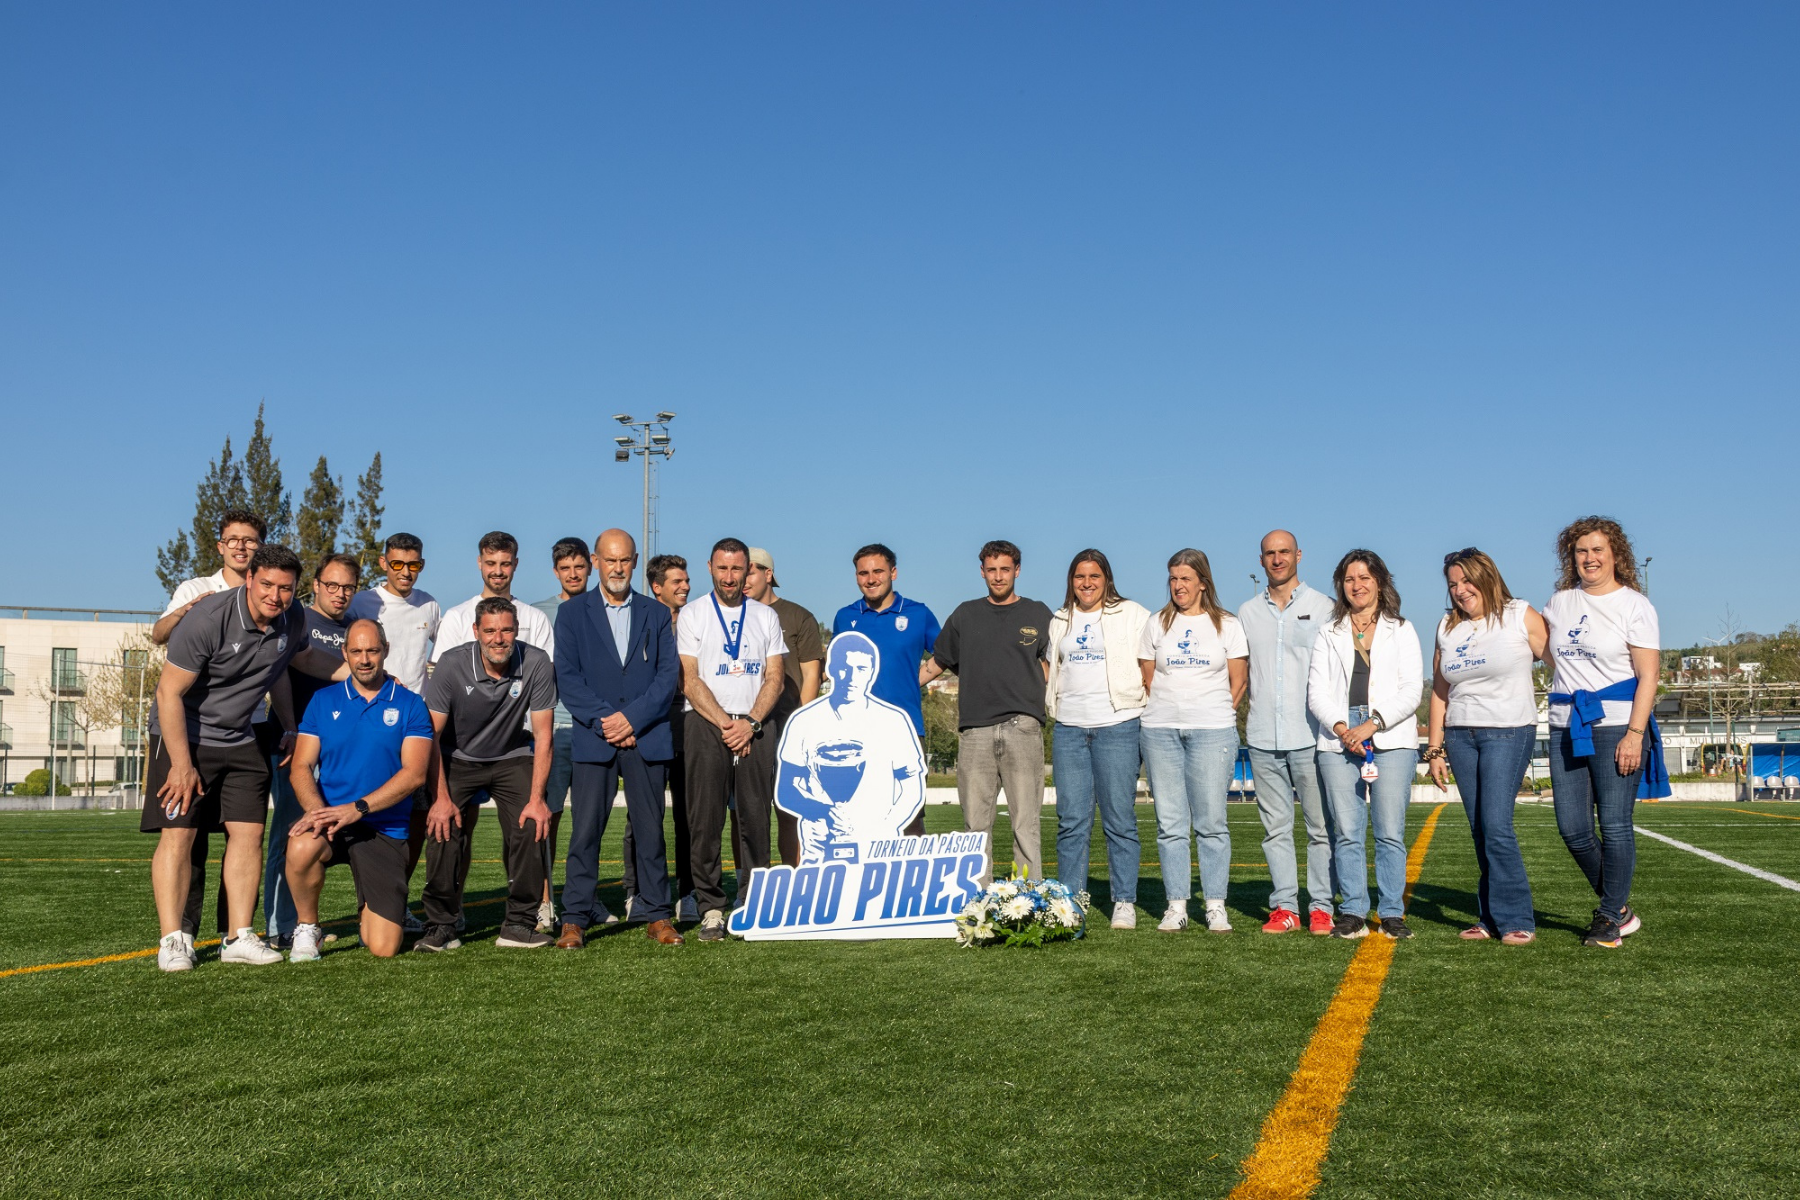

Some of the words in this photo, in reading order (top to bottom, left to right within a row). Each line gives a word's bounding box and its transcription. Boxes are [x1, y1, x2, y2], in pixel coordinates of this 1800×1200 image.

[1166, 657, 1186, 666] João
[1188, 657, 1210, 666] Pires
[867, 838, 917, 859] TORNEIO
[919, 836, 935, 855] DA
[938, 833, 983, 854] PÁSCOA
[731, 857, 847, 932] JOÃO
[852, 853, 984, 922] PIRES
